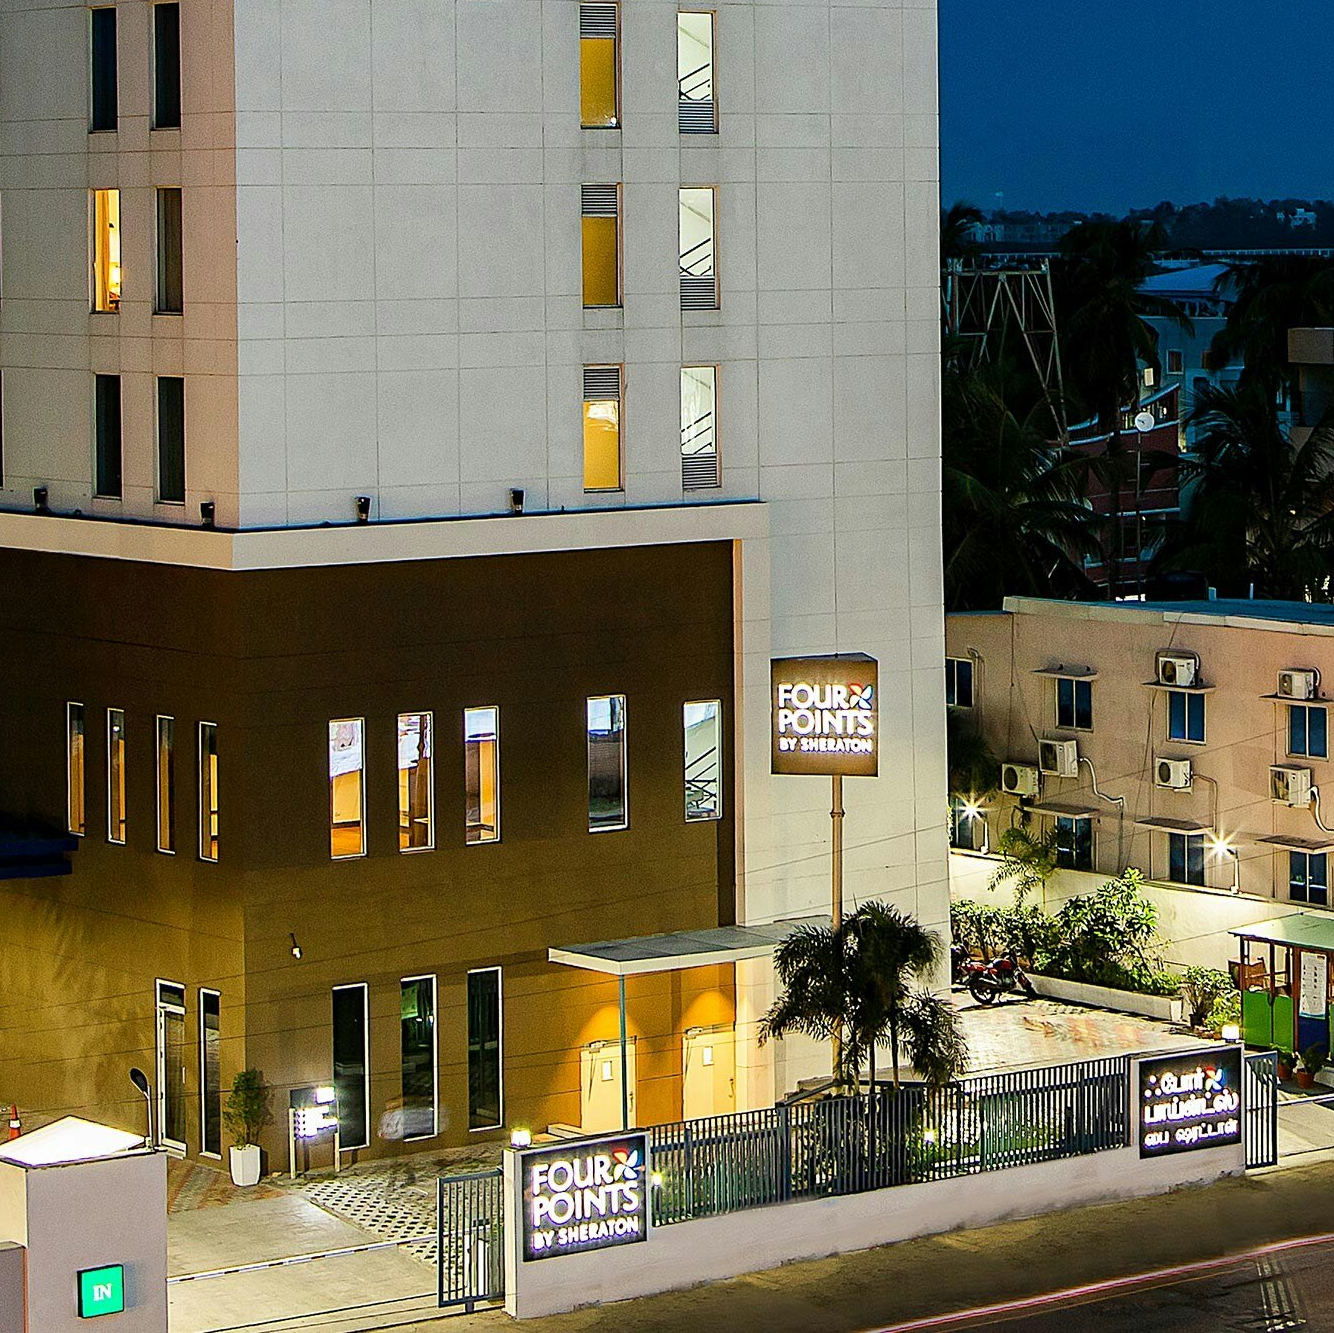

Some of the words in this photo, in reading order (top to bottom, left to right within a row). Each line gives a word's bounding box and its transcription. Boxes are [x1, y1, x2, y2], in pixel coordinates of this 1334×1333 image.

[778, 682, 849, 710] FOUR
[778, 708, 873, 736] POINTS
[778, 737, 798, 752] BY
[800, 737, 873, 754] SHERATON
[532, 1154, 614, 1196] FOUR
[533, 1180, 640, 1228] POINTS
[533, 1229, 555, 1251] BY
[558, 1216, 640, 1246] SHERATON
[92, 1283, 113, 1302] IN
